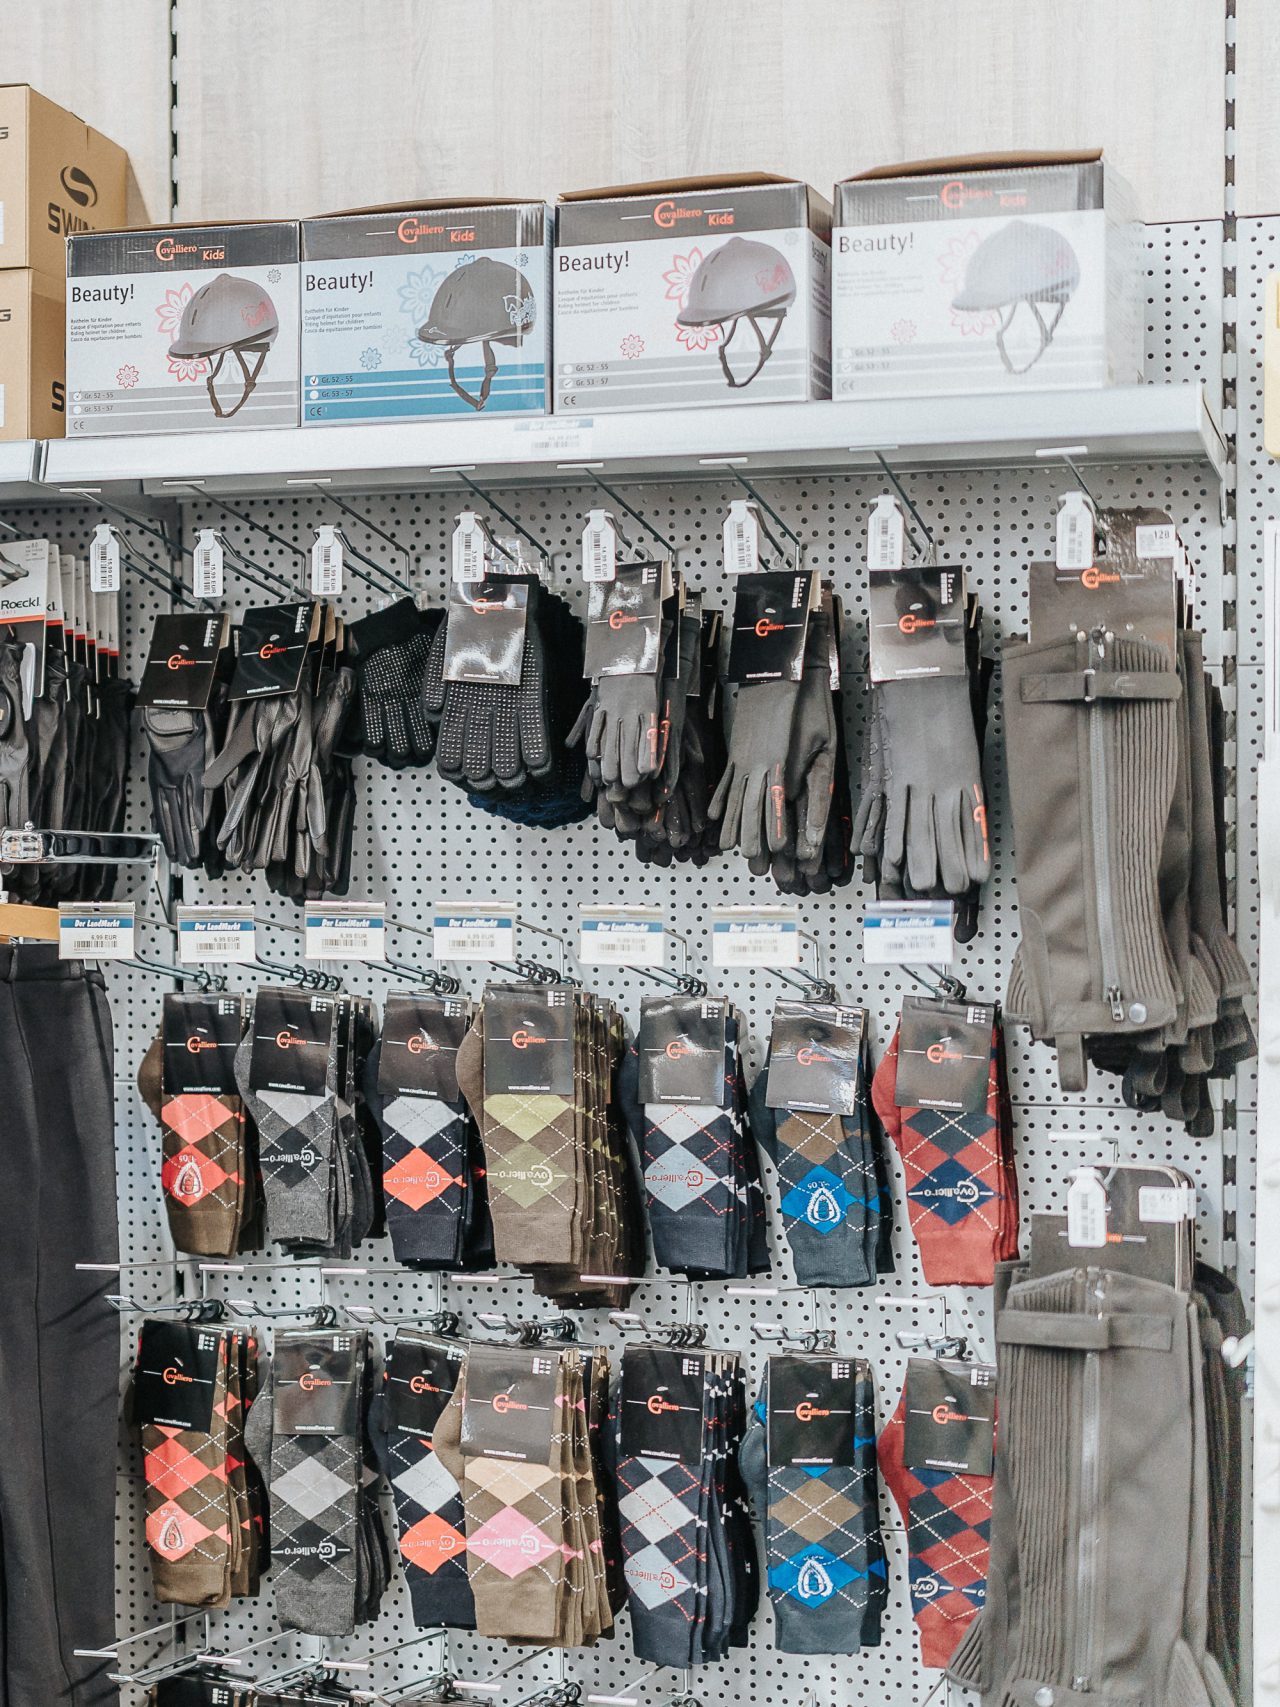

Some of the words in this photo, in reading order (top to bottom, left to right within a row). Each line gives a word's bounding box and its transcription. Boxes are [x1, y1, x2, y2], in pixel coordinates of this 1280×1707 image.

[654, 201, 702, 228] Covalliero
[708, 213, 734, 226] Kids
[398, 218, 444, 243] Covalliero
[450, 230, 475, 243] Kids
[155, 238, 197, 261] Covalliero
[203, 250, 225, 261] Kids
[839, 232, 914, 255] Beauty!
[559, 250, 629, 273] Beauty!
[306, 270, 374, 293] Beauty!
[72, 283, 134, 304] Beauty!
[586, 363, 594, 372] 52
[601, 363, 608, 371] 55
[576, 379, 584, 387] Gr.
[586, 378, 594, 386] 53
[107, 391, 114, 399] 55
[1, 597, 40, 609] Roeckl
[755, 618, 784, 637] Covalliero
[259, 643, 287, 659] Covalliero
[167, 654, 195, 670] Covalliero
[74, 919, 85, 927] Der
[87, 919, 120, 927] LandMarkt
[194, 922, 205, 930] Der
[207, 922, 240, 931] LandMarkt
[322, 919, 333, 927] Der
[334, 919, 370, 928] LandMarkt
[449, 919, 460, 927] Der
[462, 919, 497, 927] LandMarkt
[597, 922, 609, 931] Der
[611, 923, 649, 932] LandMarkt
[729, 923, 742, 932] Der
[743, 923, 782, 932] LandMarkt
[880, 918, 894, 927] Der
[895, 918, 935, 928] LandMarkt
[187, 1036, 217, 1053] Covalliero
[276, 1031, 306, 1049] Covalliero
[511, 1030, 546, 1049] Covalliero
[926, 1044, 962, 1063] Covalliero
[270, 1149, 315, 1167] Covalliero
[392, 1171, 440, 1189] Covalliero
[498, 1164, 553, 1186] Covalliero
[650, 1170, 704, 1187] Covalliero
[924, 1180, 980, 1203] Covalliero
[163, 1367, 193, 1384] Covalliero
[299, 1373, 332, 1391] Covalliero
[410, 1376, 440, 1393] Covalliero
[492, 1394, 528, 1413] Covalliero
[647, 1395, 679, 1414] Covalliero
[795, 1402, 830, 1421] Covalliero
[932, 1404, 967, 1424] Covalliero
[284, 1541, 336, 1559] Covalliero
[406, 1534, 456, 1551] Covalliero
[479, 1534, 540, 1555] Covalliero
[629, 1569, 675, 1589] Covalliero
